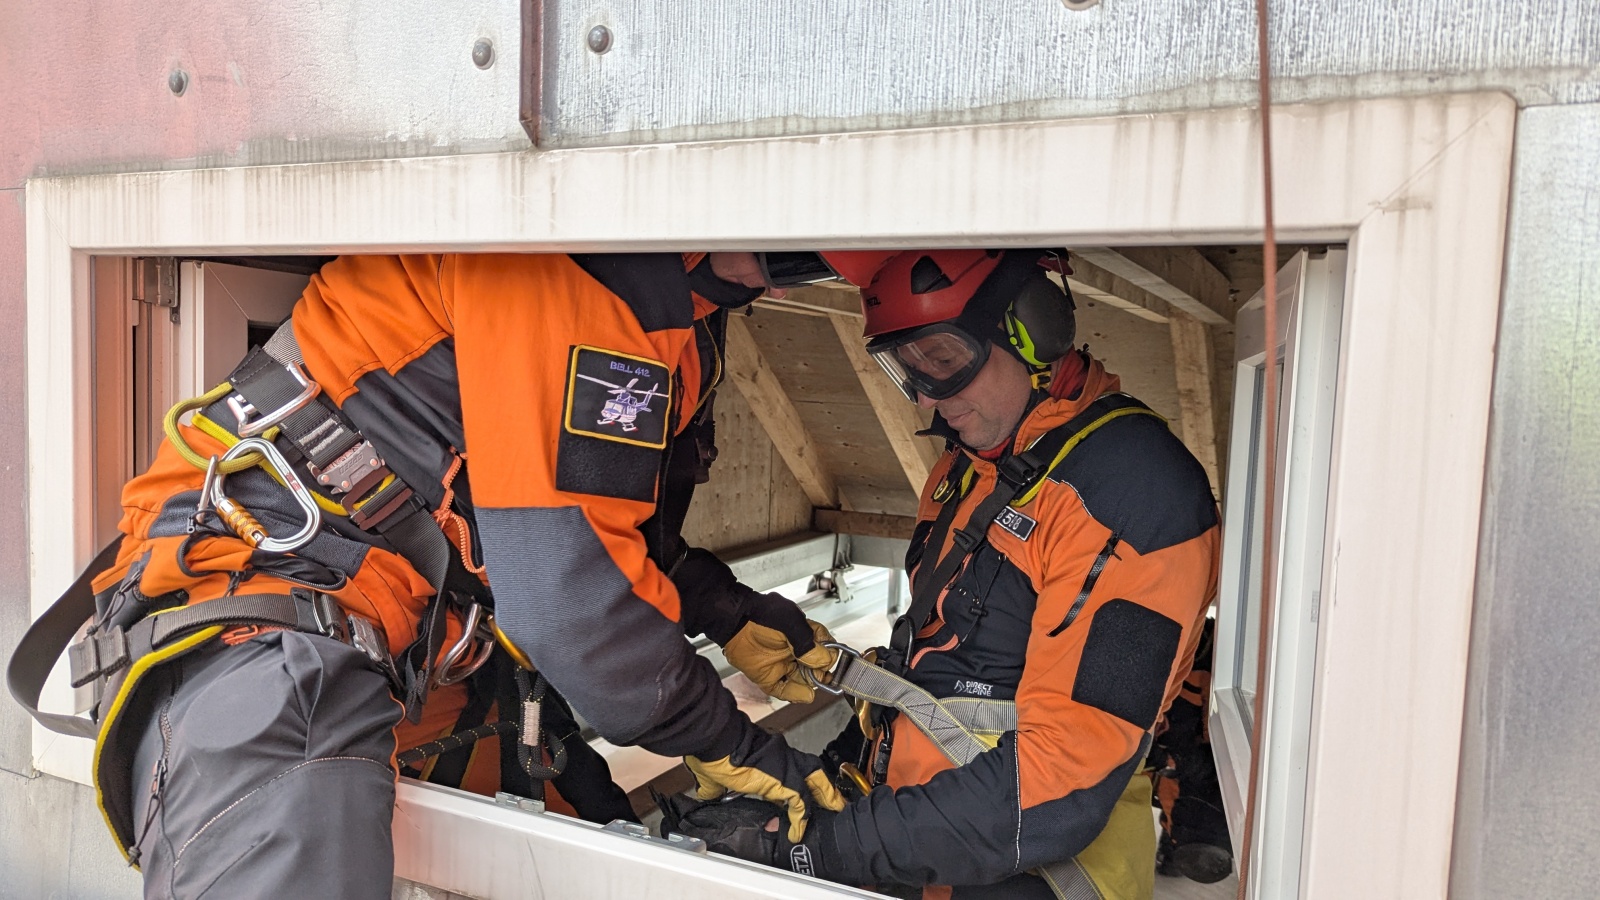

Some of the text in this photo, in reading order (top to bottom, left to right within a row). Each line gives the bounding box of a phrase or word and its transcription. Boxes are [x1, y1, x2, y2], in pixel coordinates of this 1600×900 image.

[610, 361, 651, 377] BELL 412
[966, 681, 993, 691] DIRECT
[963, 687, 992, 697] ALPINE
